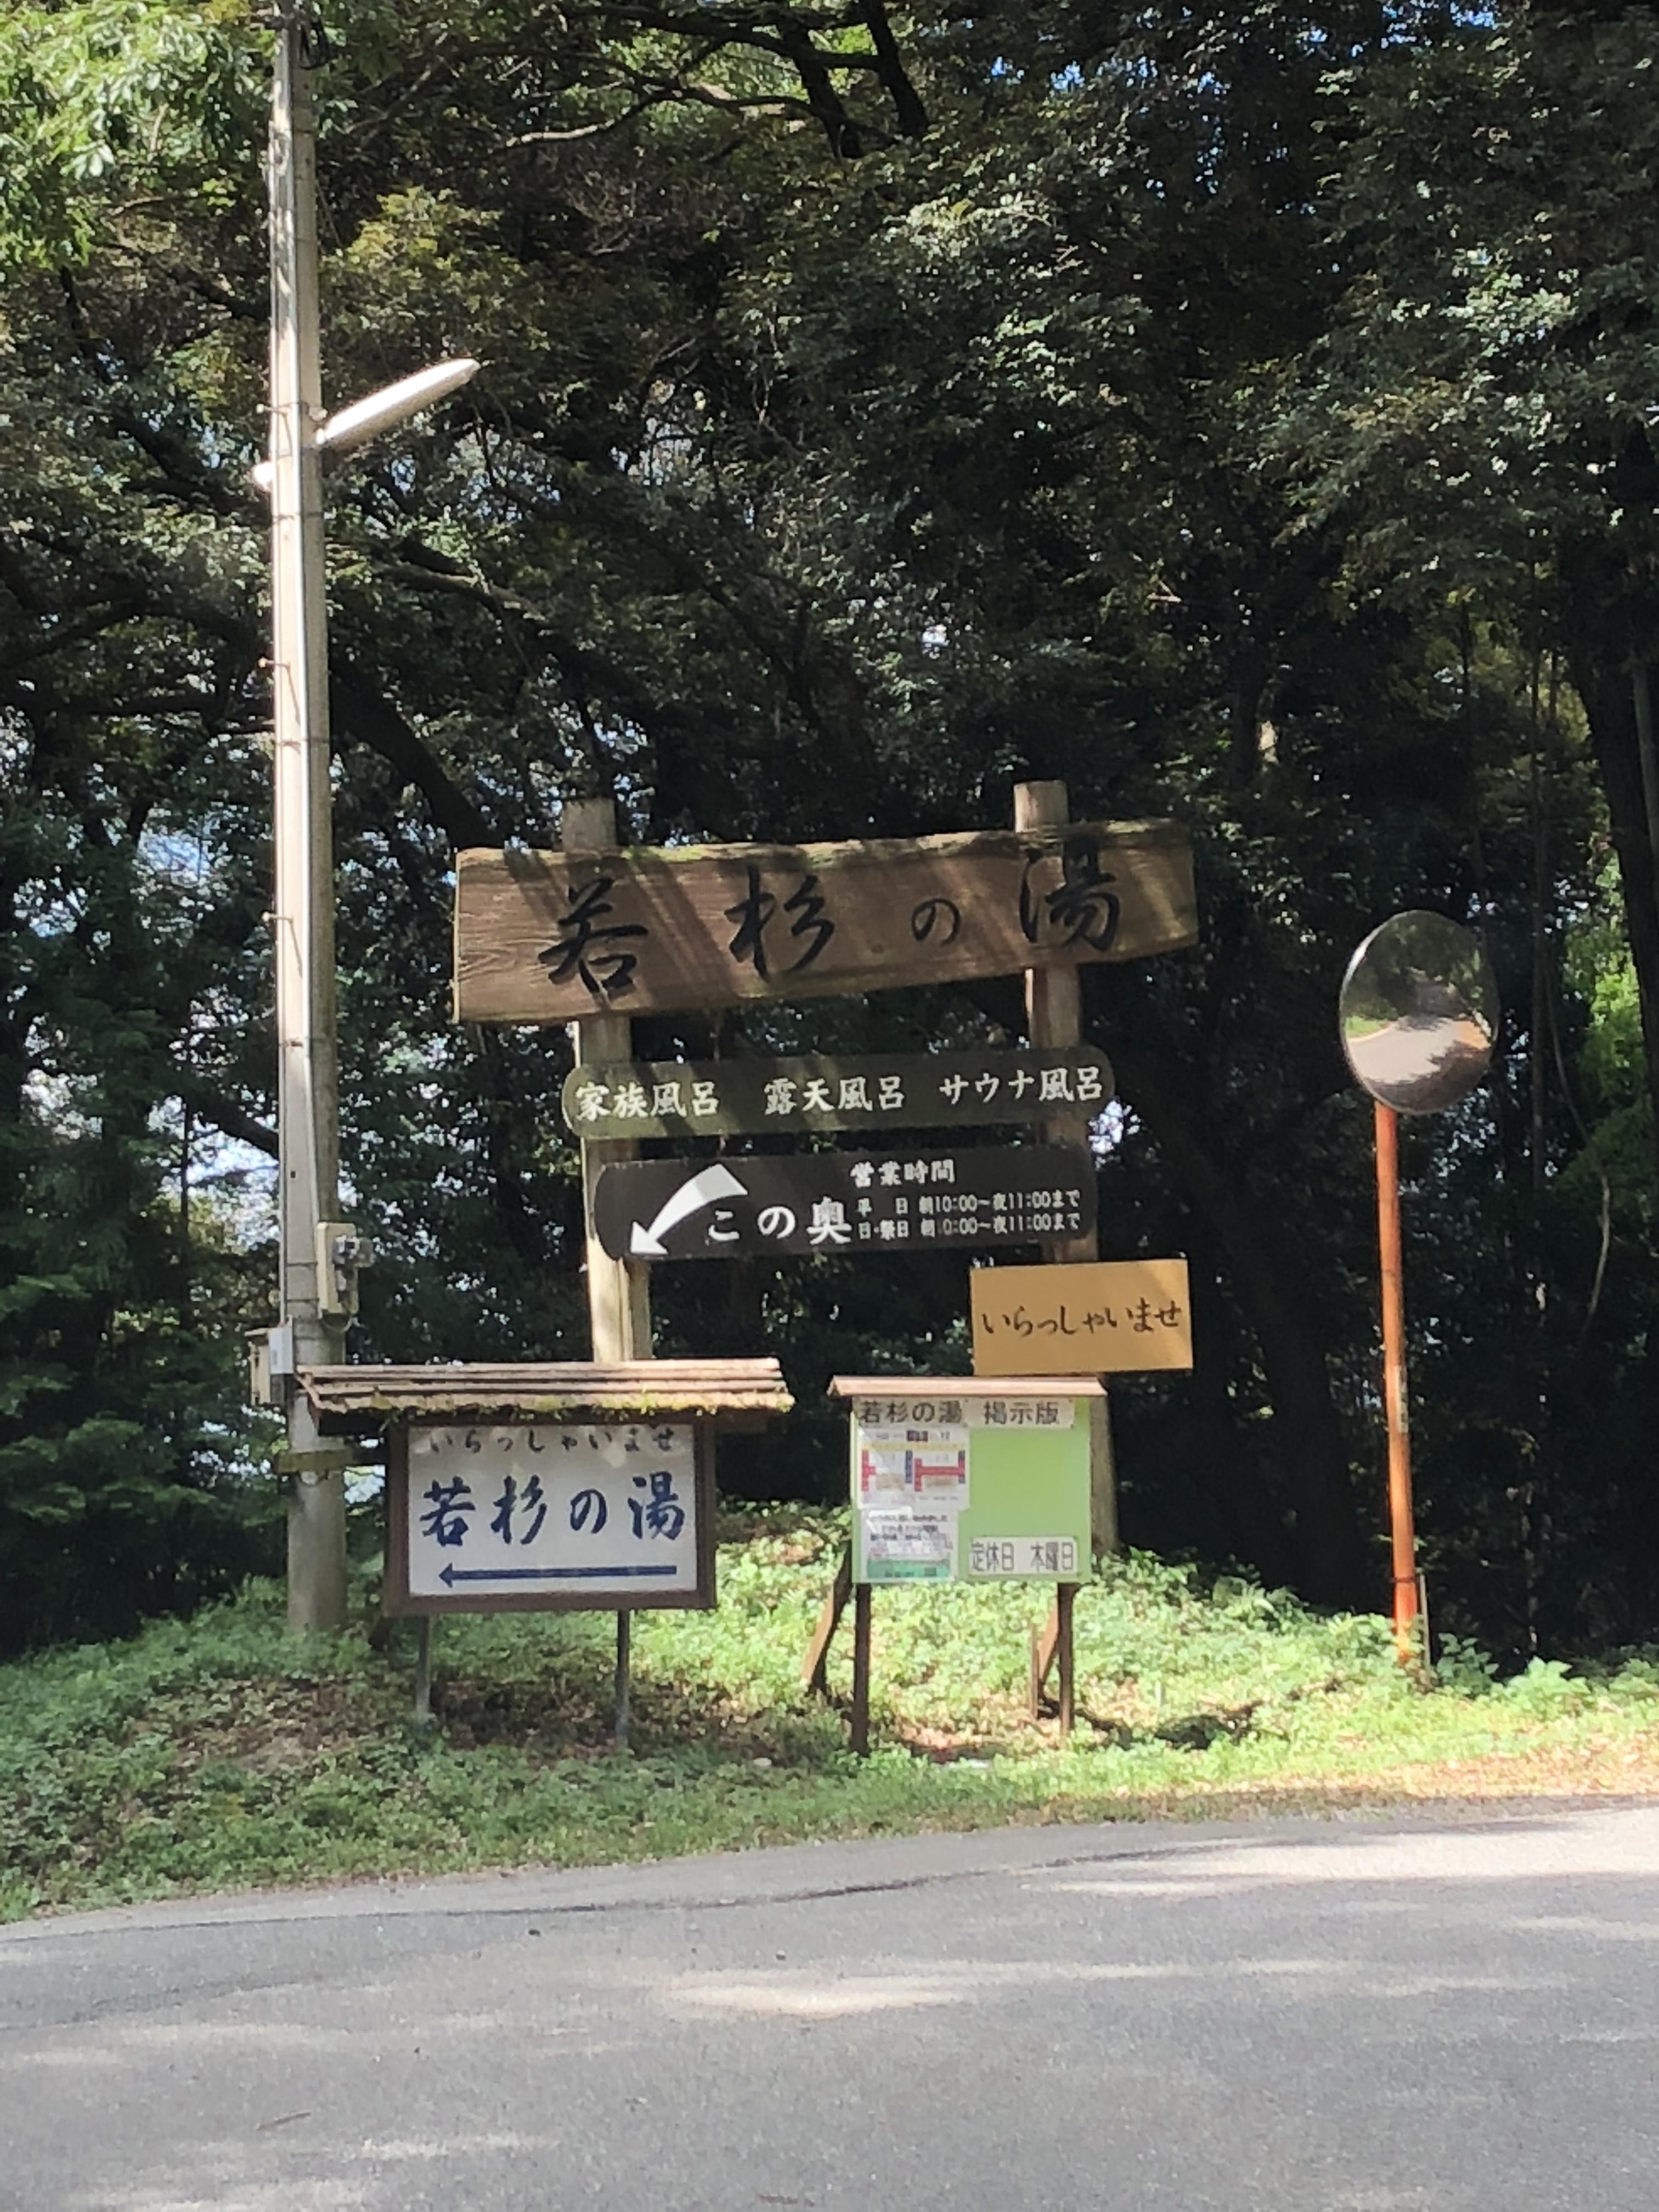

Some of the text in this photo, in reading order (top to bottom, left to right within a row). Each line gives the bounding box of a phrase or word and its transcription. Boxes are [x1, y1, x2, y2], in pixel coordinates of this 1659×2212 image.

[538, 845, 1120, 1000] 若杉の湯
[574, 1065, 1104, 1120] 家族風呂 露天風呂 サウナ風呂
[850, 1159, 956, 1188] 営業時間
[706, 1196, 852, 1244] この奥
[982, 1296, 1182, 1336] いらっしゃいませ
[859, 1400, 963, 1424] 若杉の湯
[430, 1427, 674, 1452] いらっしゃいませ
[420, 1470, 685, 1547] 若杉の湯
[971, 1541, 1014, 1572] 定休日
